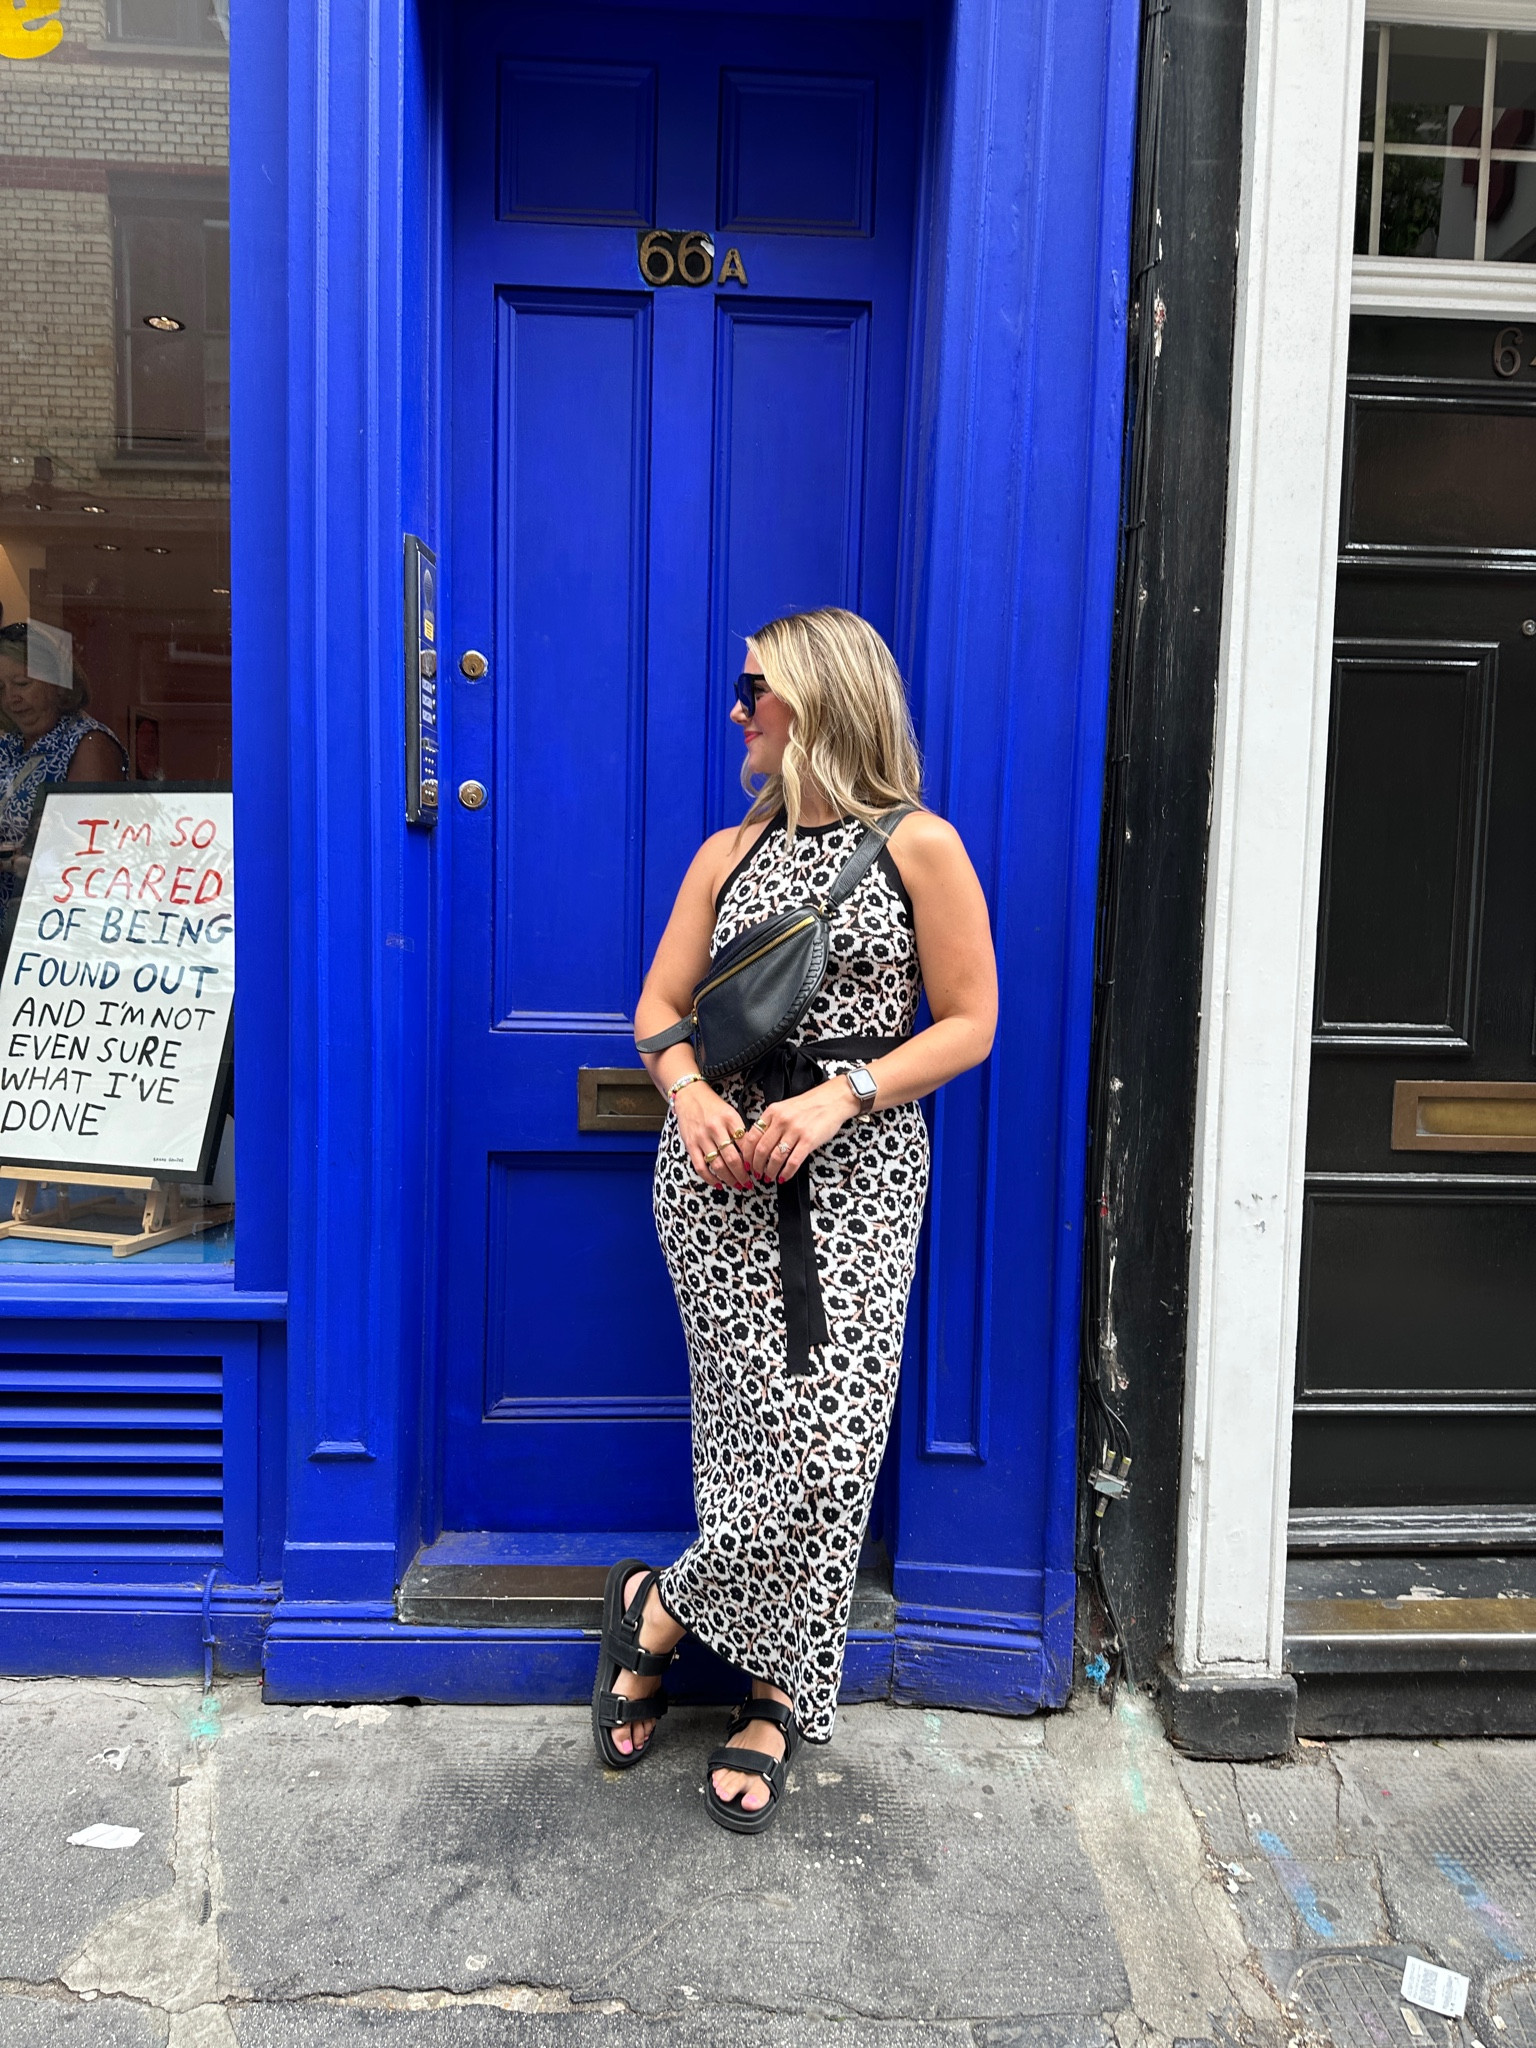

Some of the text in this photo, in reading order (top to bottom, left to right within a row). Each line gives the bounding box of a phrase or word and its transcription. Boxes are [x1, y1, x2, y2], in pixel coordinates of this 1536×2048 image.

[75, 816, 217, 856] I'M SO
[53, 864, 223, 905] SCARED
[38, 906, 233, 947] OF BEING
[14, 952, 219, 998] FOUND OUT
[12, 997, 216, 1031] AND I'M NOT
[8, 1034, 182, 1069] EVEN SURE
[1, 1066, 180, 1105] WHAT I'VE
[0, 1100, 106, 1136] DONE
